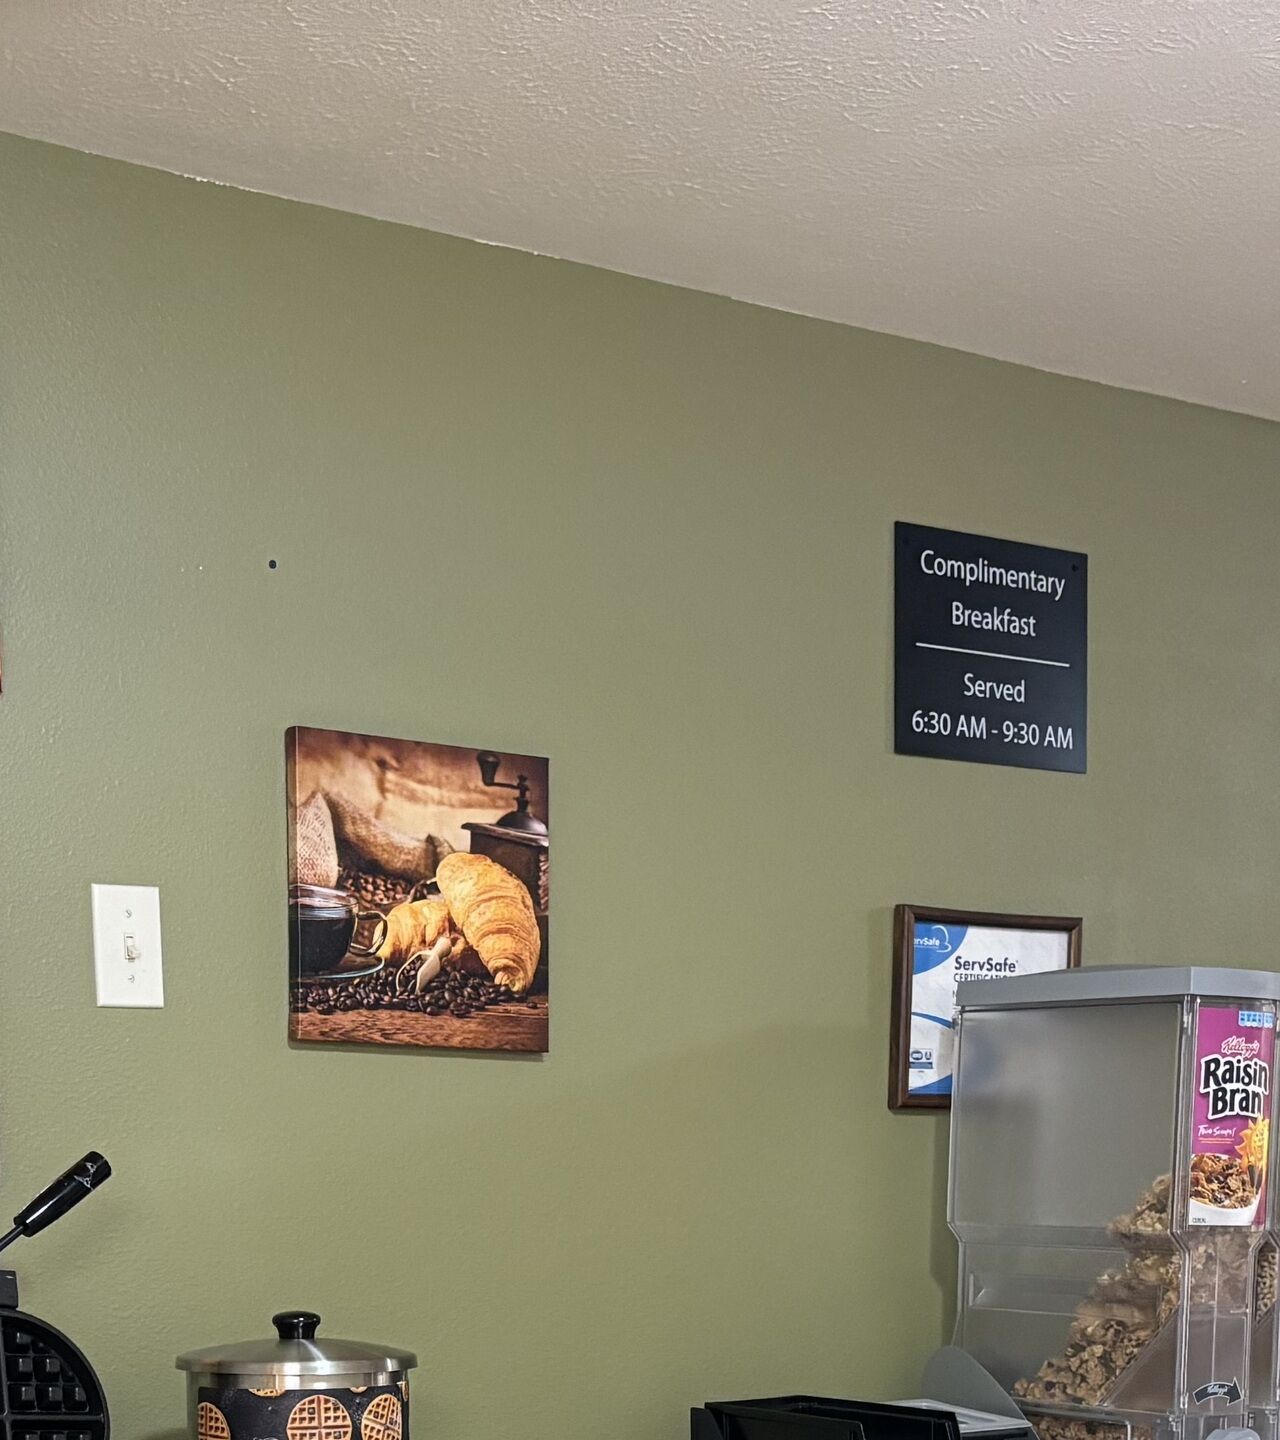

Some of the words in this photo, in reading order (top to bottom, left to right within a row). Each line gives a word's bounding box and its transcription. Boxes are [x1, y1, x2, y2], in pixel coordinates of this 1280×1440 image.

[920, 550, 1065, 601] Complimentary
[952, 602, 1036, 637] Breakfast
[964, 673, 1025, 702] Served
[912, 710, 951, 735] 6:30
[956, 715, 986, 740] AM
[1003, 721, 1039, 745] 9:30
[1044, 726, 1073, 749] AM
[954, 956, 1016, 972] ServSafe
[1222, 1037, 1259, 1057] Kellogg's
[1202, 1057, 1268, 1094] Raisin
[1211, 1086, 1263, 1117] Bran
